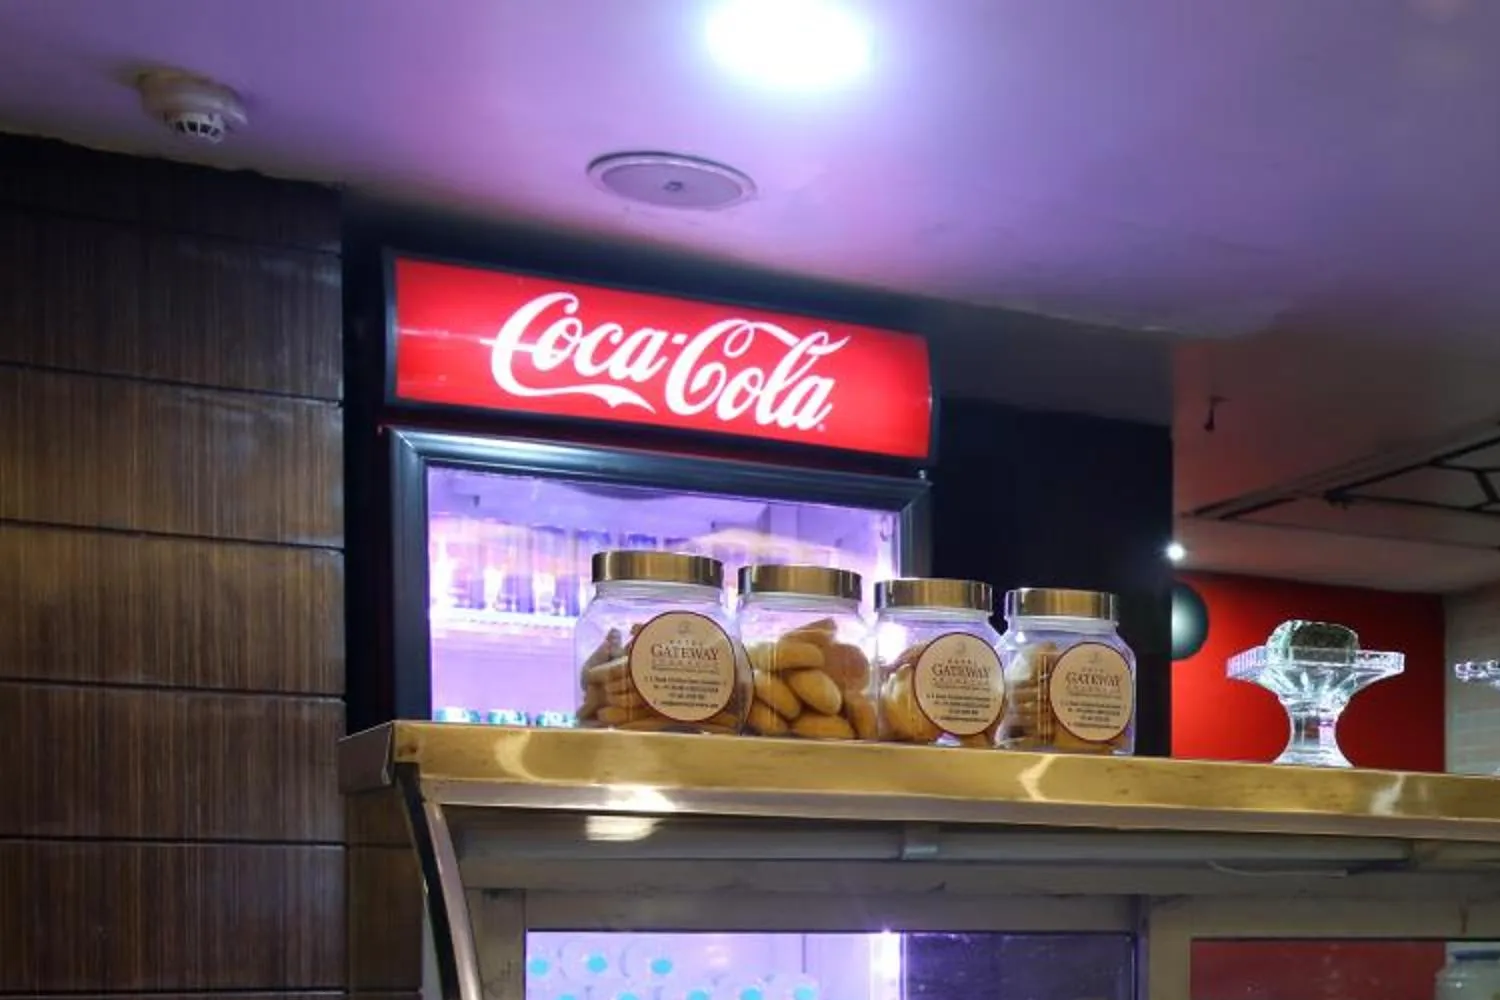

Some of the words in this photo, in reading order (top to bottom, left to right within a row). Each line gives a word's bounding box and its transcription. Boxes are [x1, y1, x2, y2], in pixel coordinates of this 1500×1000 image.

[490, 291, 851, 431] Coca-Cola
[650, 642, 720, 662] GATEWAY
[930, 662, 991, 679] GATEWAY
[1065, 671, 1121, 687] GATEWAY
